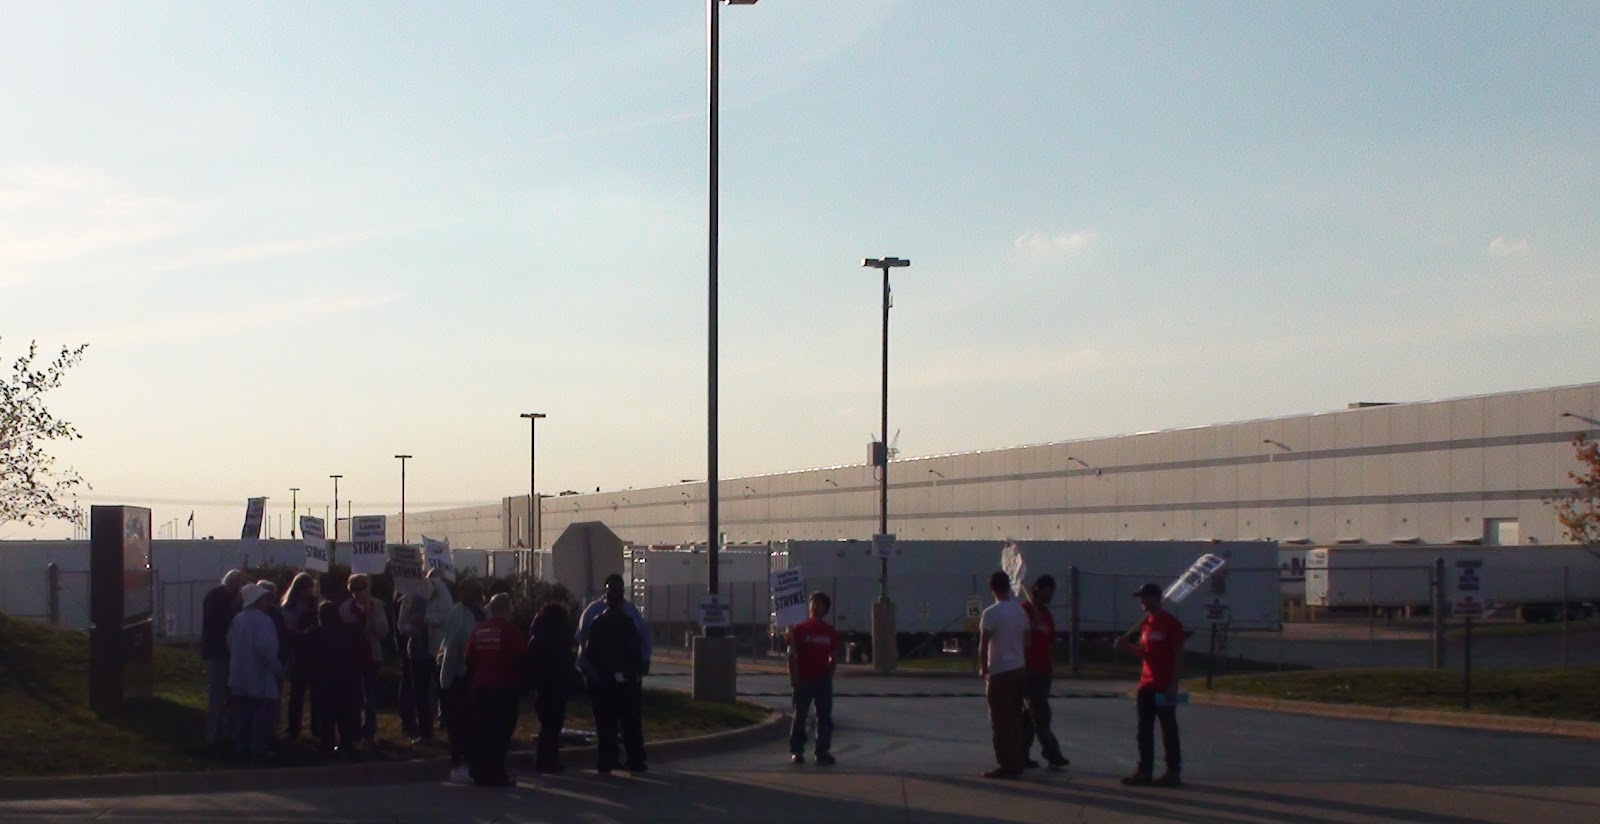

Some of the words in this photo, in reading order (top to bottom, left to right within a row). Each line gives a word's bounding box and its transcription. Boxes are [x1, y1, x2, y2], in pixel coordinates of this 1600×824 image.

[305, 545, 327, 562] STRIKE
[353, 541, 385, 555] STRIKE
[392, 566, 421, 578] STRIKE
[775, 592, 805, 611] STRIKE
